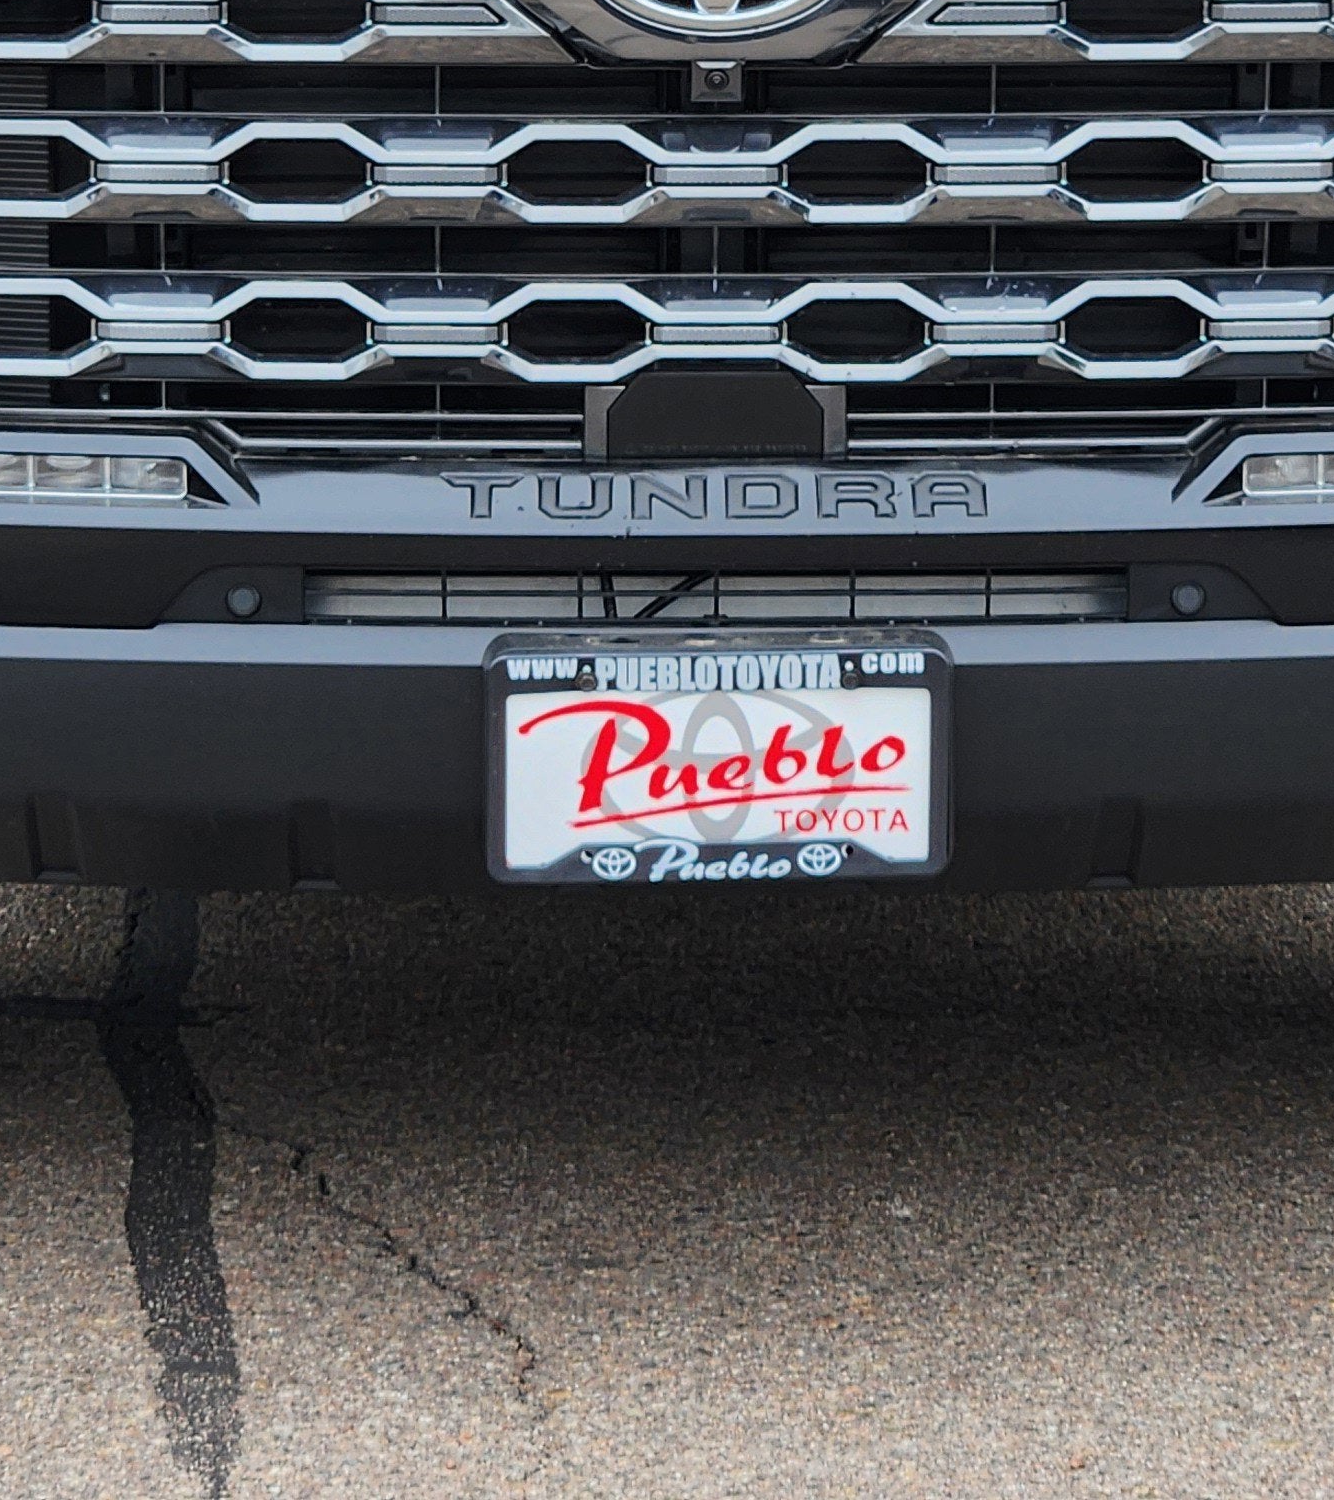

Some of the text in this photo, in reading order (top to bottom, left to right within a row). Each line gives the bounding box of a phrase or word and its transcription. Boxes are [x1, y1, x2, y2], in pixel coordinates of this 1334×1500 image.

[440, 471, 988, 520] TUNDRA
[518, 700, 907, 813] Pueblo
[776, 809, 909, 833] TOYOTA
[634, 838, 792, 883] Pueblo
